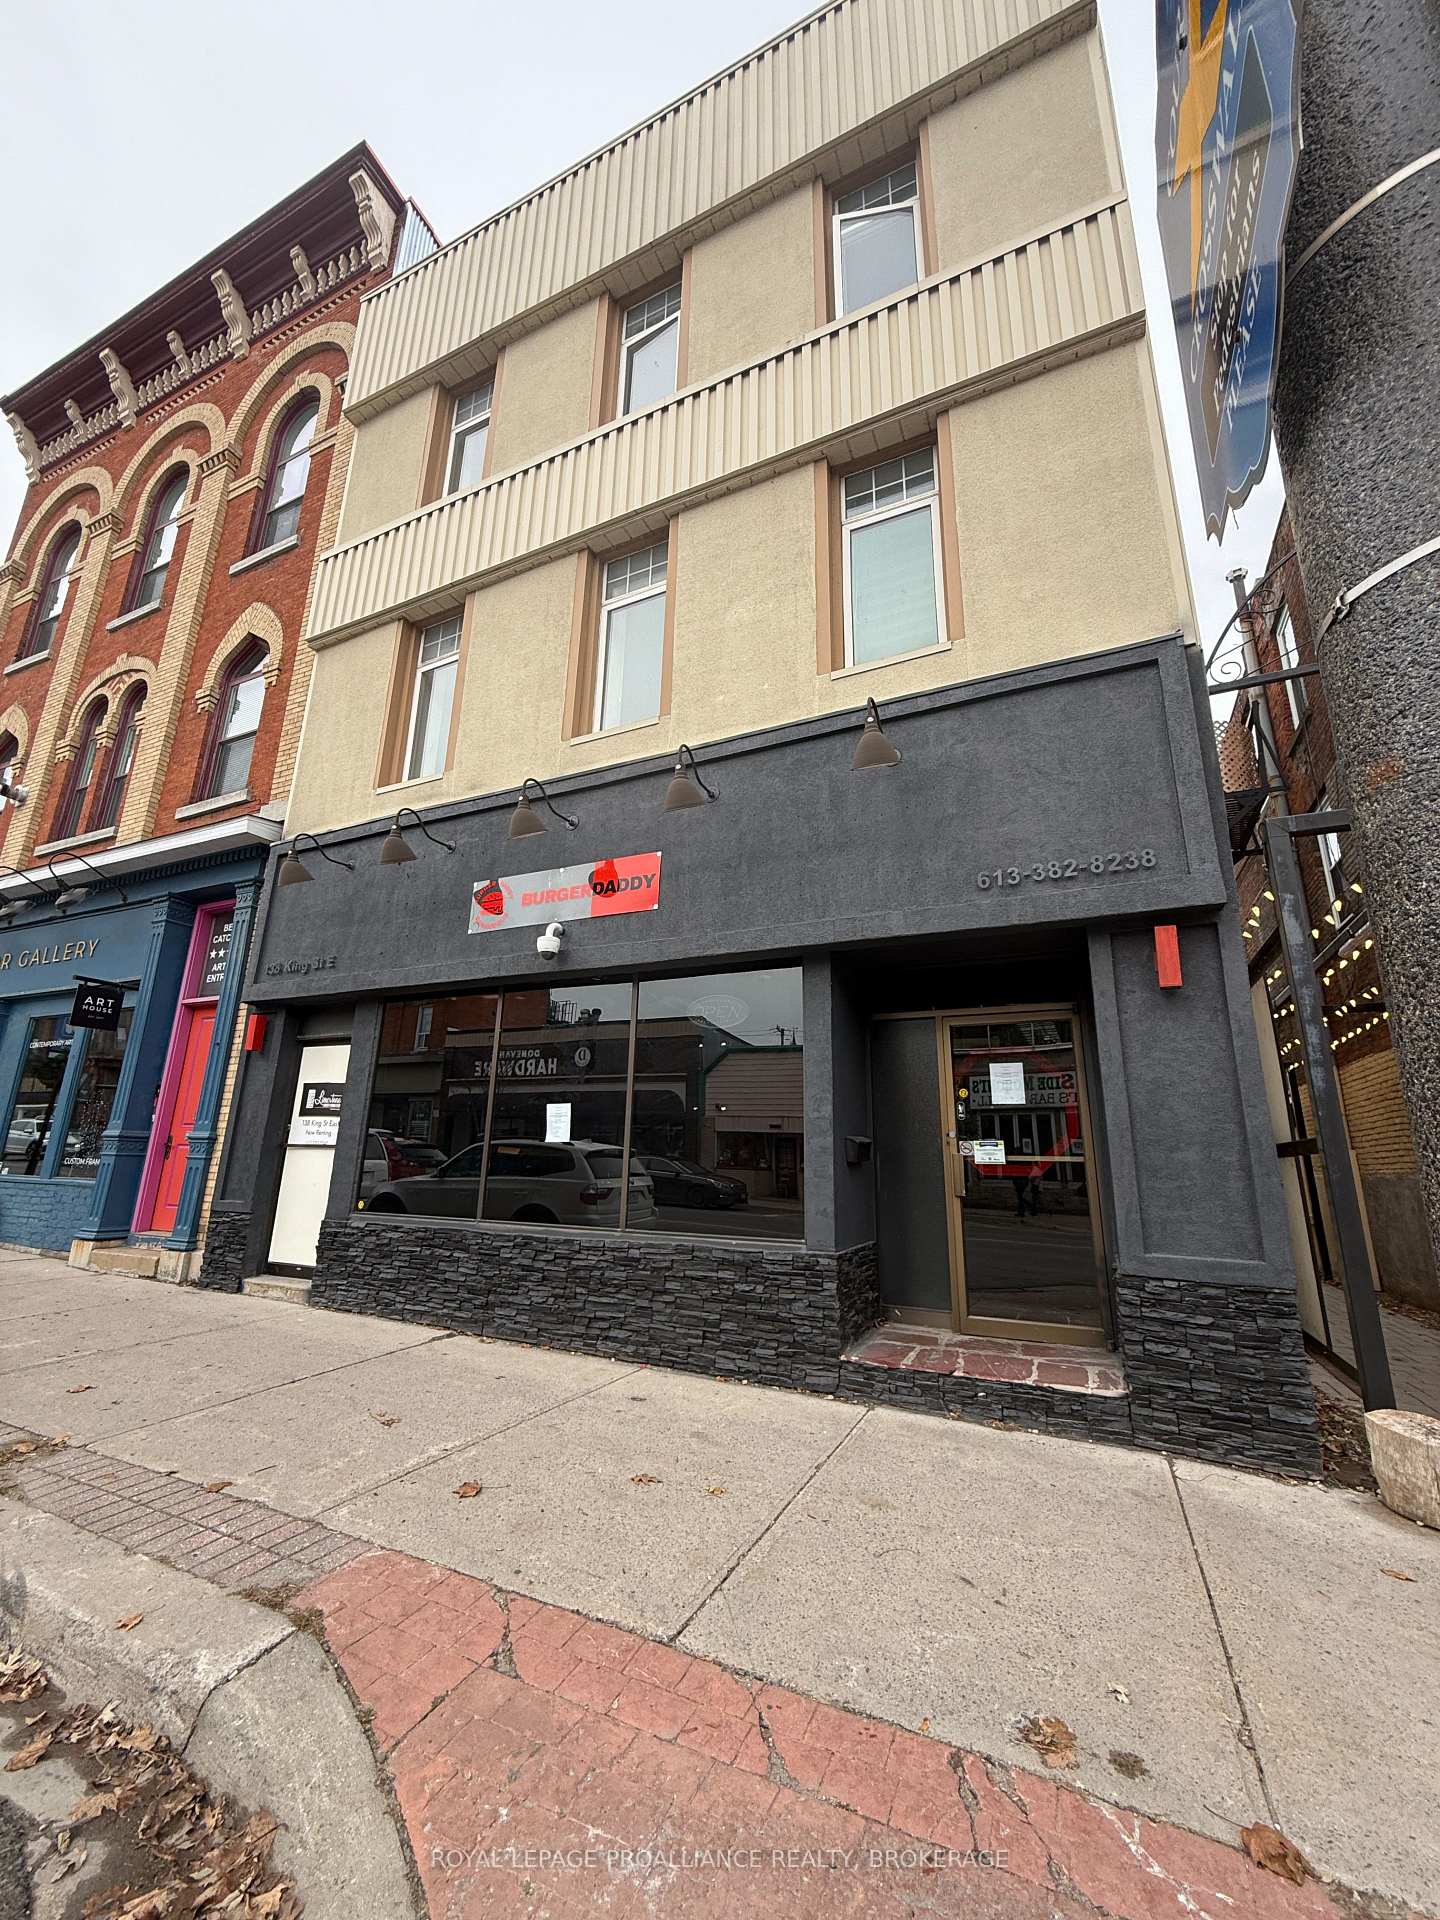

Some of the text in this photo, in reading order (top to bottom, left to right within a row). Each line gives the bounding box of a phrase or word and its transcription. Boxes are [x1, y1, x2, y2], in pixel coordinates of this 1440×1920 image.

[1190, 0, 1244, 383] CROSSWAL
[1210, 157, 1242, 350] Stop for
[1213, 151, 1260, 418] Pedestrians
[1225, 254, 1263, 434] PLEASE
[977, 848, 1157, 889] 613-382-8238
[18, 939, 100, 968] GALLERY
[82, 1004, 113, 1014] HOUSE
[84, 996, 116, 1008] ART
[64, 1158, 85, 1166] CUSTOM
